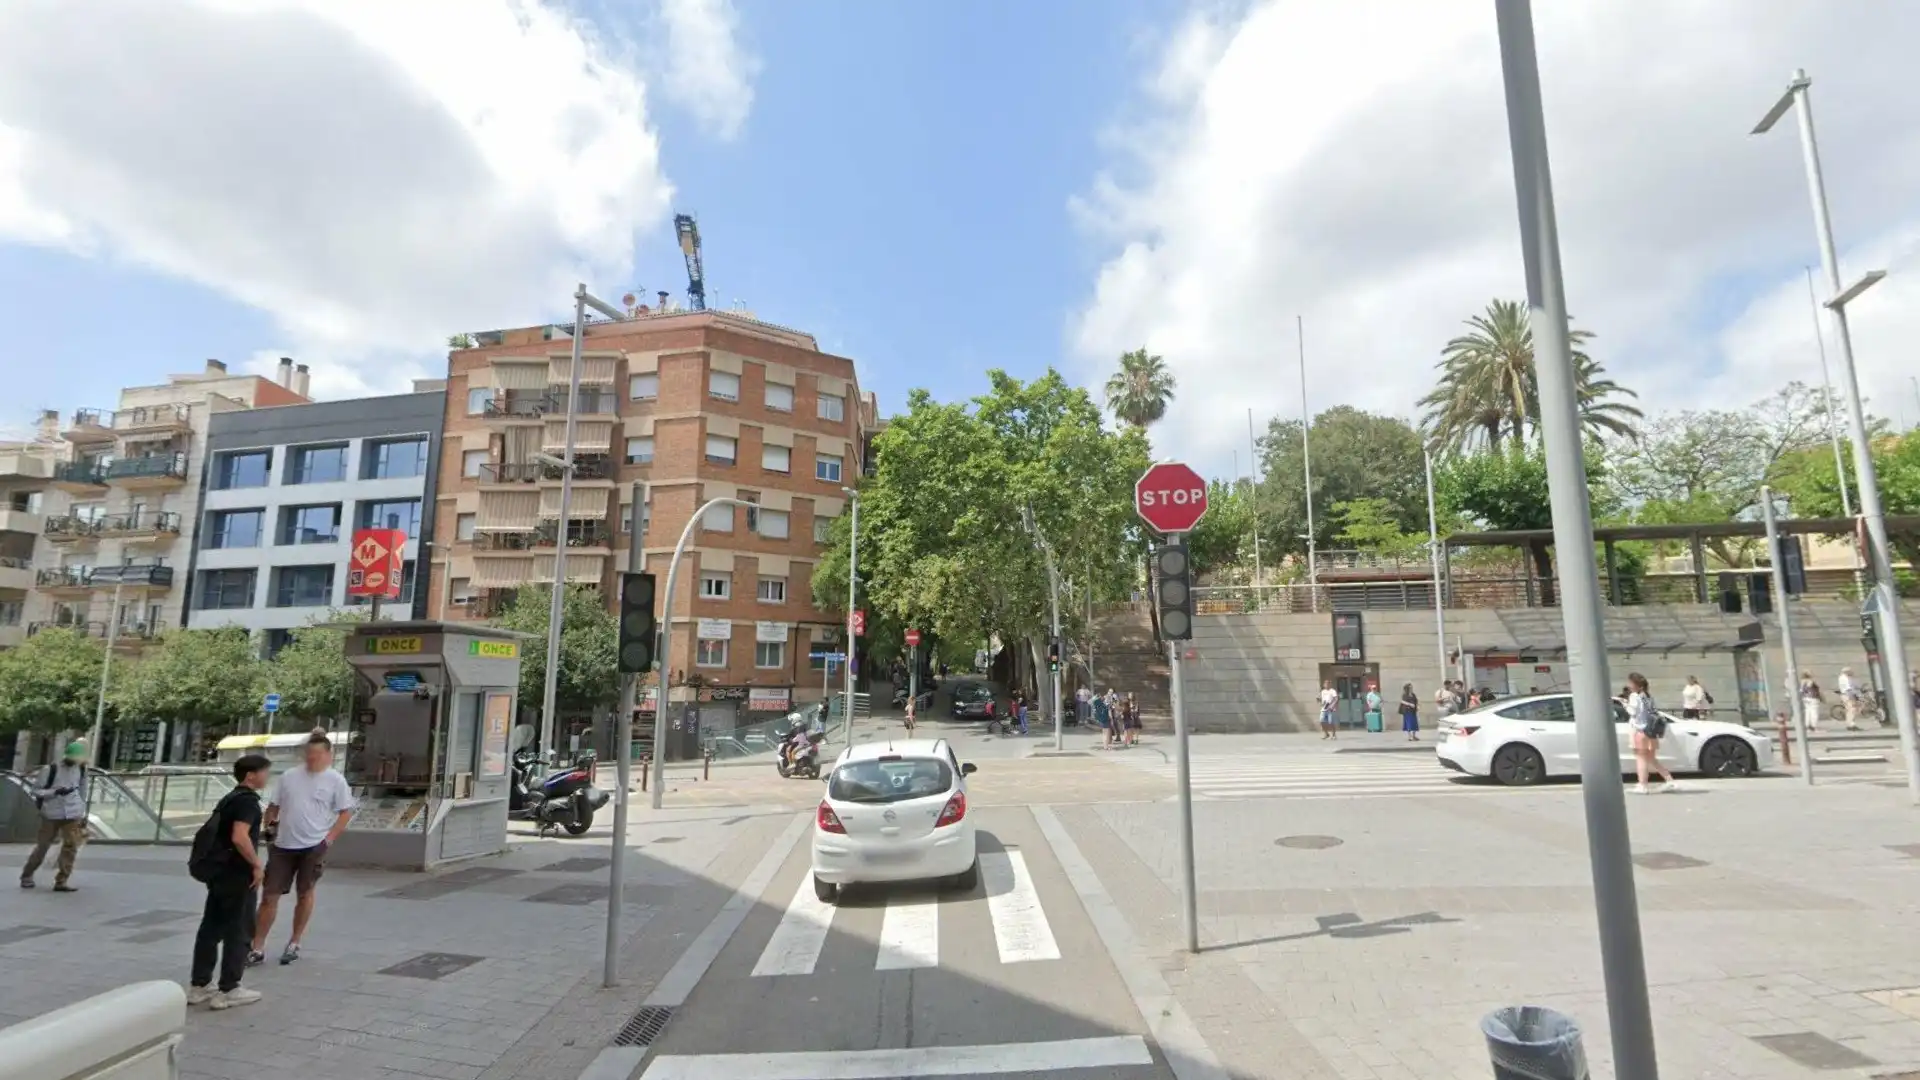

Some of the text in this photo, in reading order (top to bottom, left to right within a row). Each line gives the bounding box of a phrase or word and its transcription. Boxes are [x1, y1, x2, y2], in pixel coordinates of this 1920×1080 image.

[1142, 488, 1203, 506] STOP
[361, 544, 376, 560] M
[381, 638, 416, 650] ONCE
[483, 643, 513, 655] ONCE
